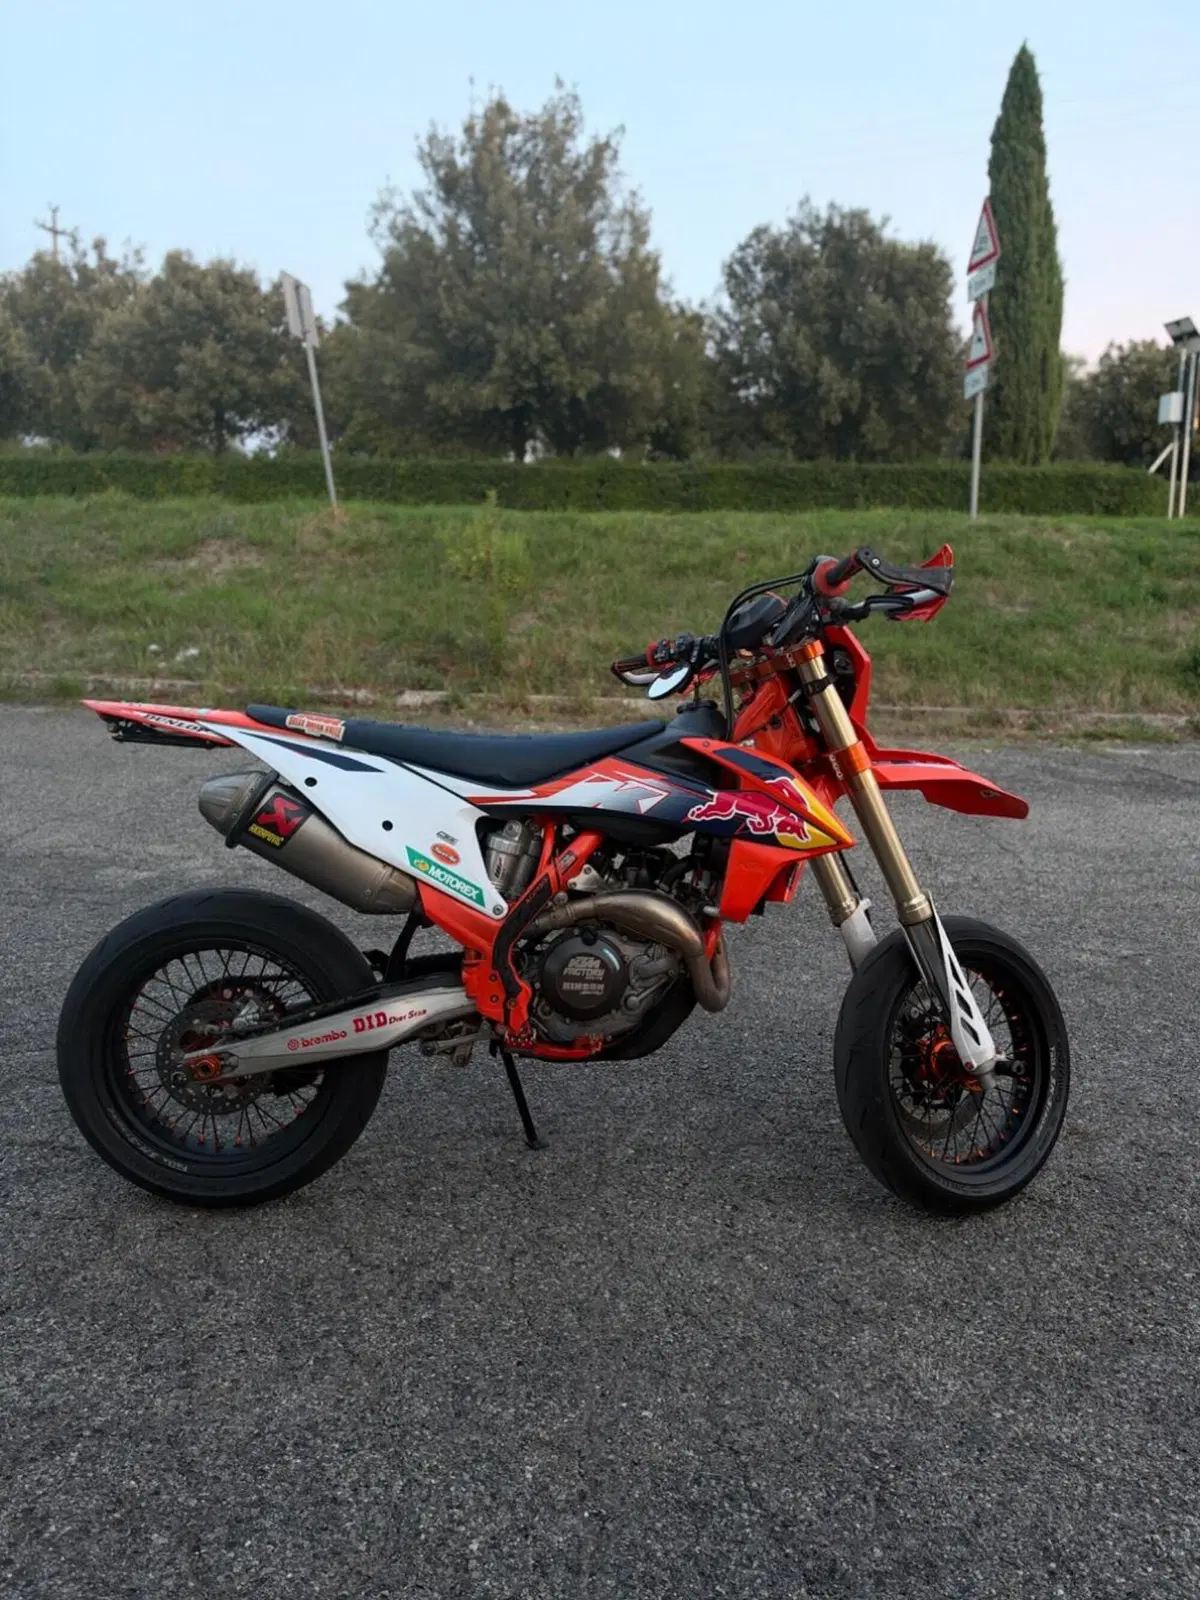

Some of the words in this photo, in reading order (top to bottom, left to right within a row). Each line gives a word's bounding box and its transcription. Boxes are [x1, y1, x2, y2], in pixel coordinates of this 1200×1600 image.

[428, 866, 479, 899] MOTOREX
[563, 968, 605, 977] FACTORY
[302, 1030, 347, 1048] brembo
